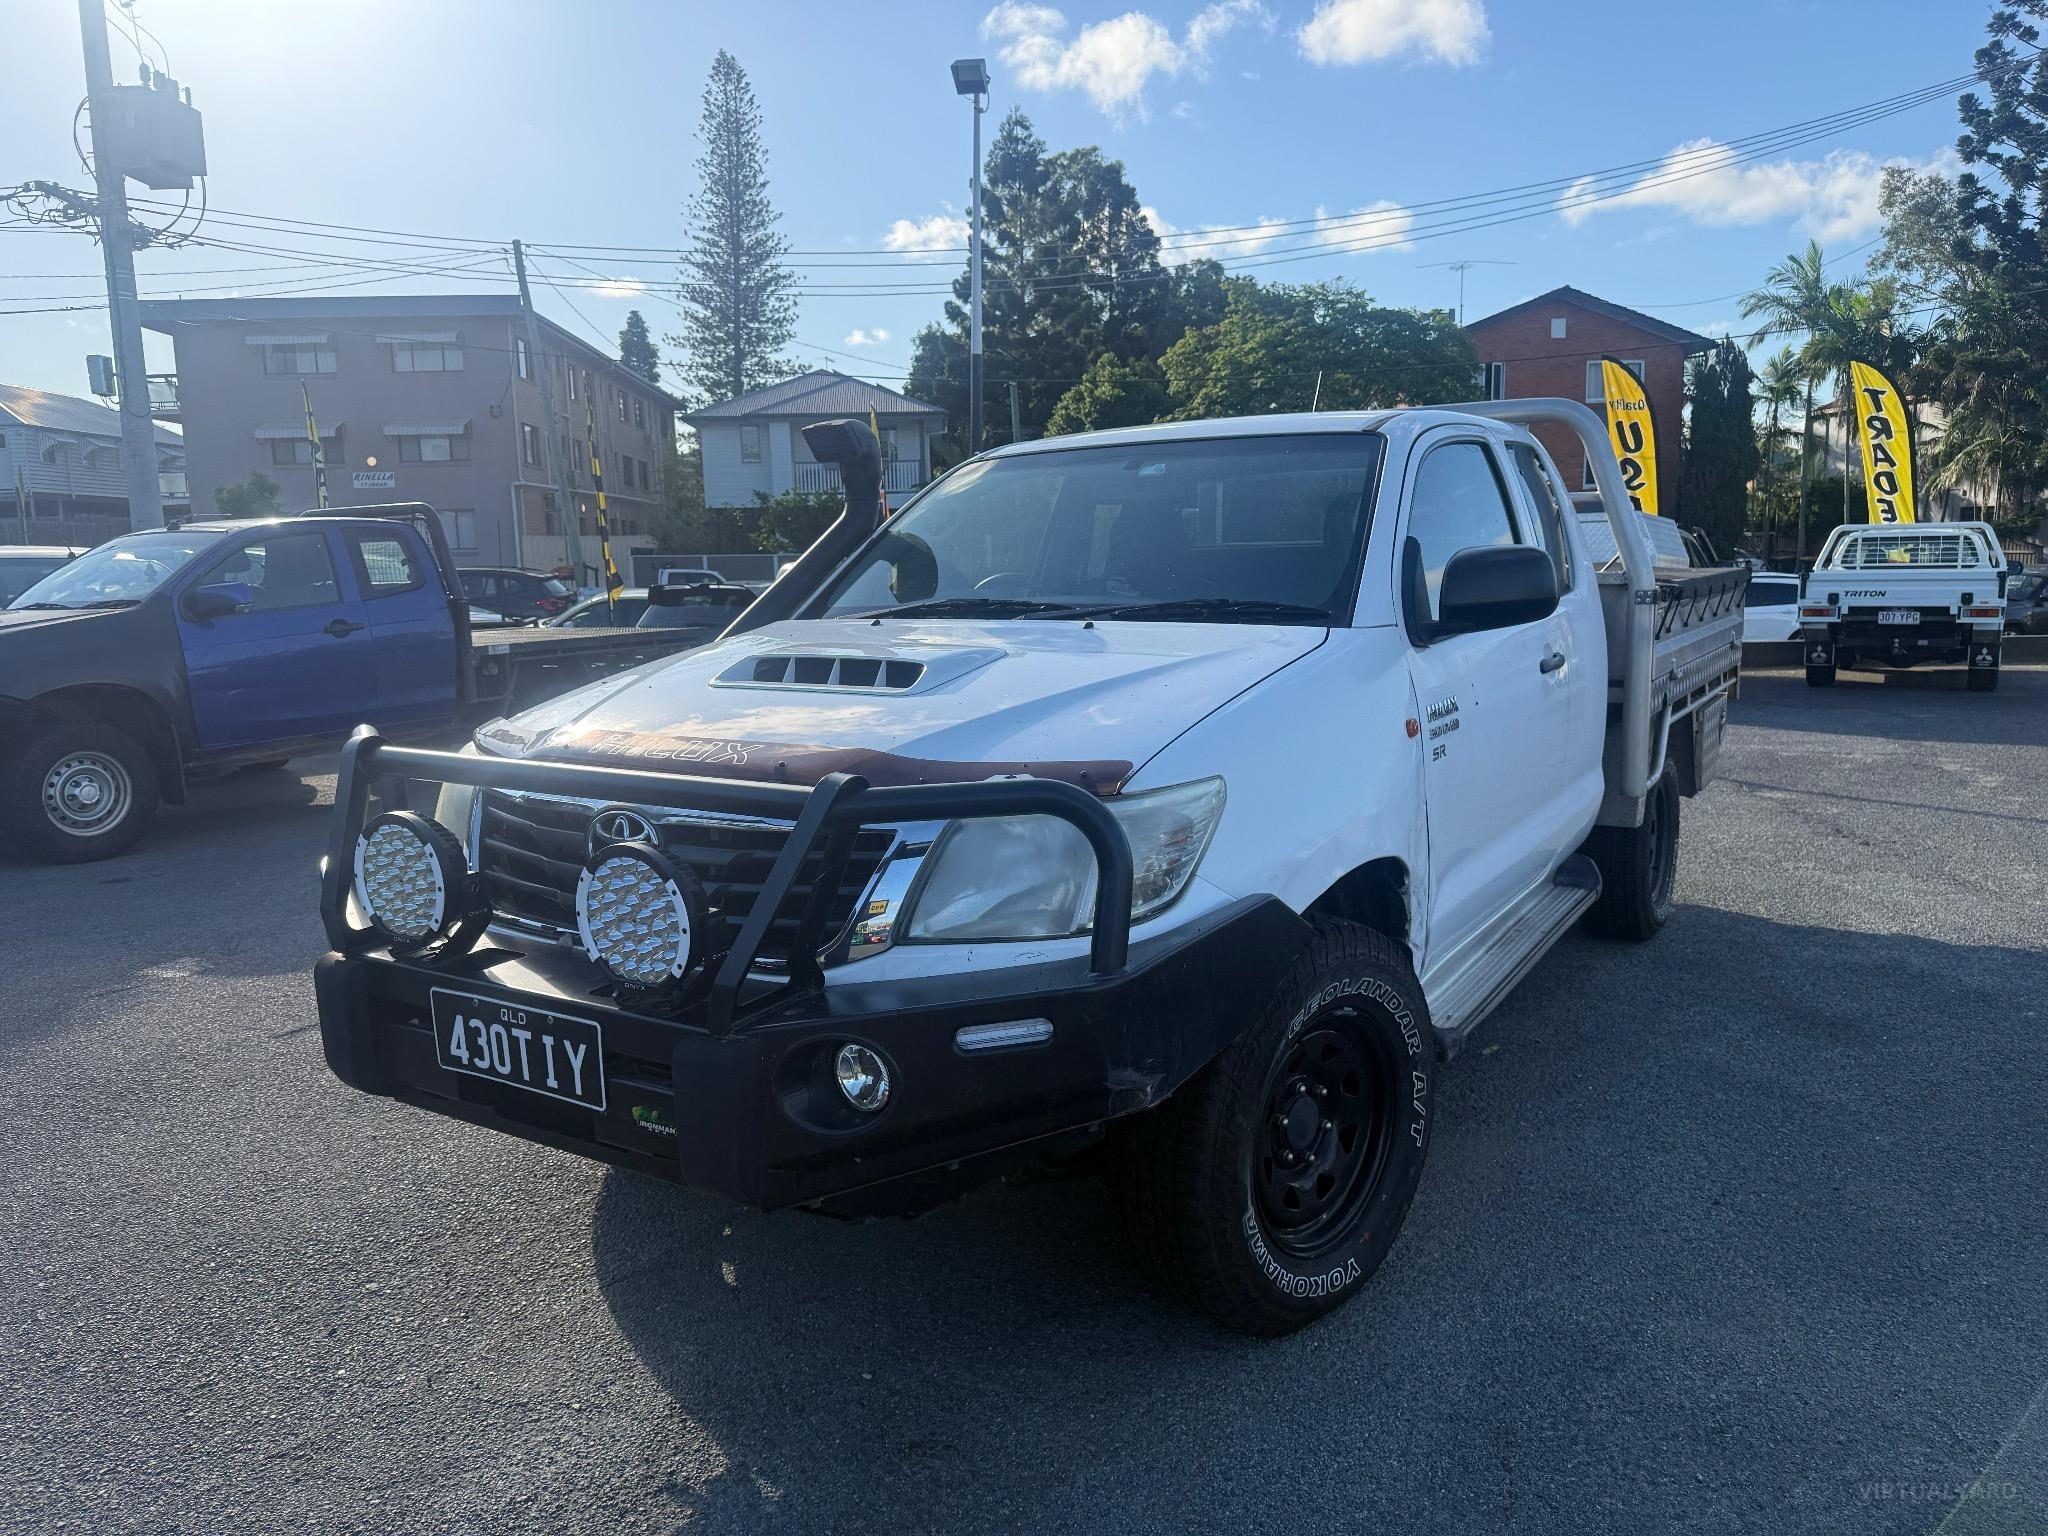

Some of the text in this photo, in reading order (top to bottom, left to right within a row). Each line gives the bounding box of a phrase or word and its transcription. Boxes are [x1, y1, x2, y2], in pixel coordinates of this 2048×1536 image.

[353, 472, 394, 481] RINELLA
[1843, 590, 1886, 598] TRITON
[1879, 612, 1918, 622] 307 YPG
[1426, 695, 1459, 723] HILUX
[588, 734, 765, 765] HILUX
[1432, 743, 1447, 762] SR
[500, 1008, 527, 1025] QLD
[1288, 977, 1427, 1147] GEOLANDAR A/T
[639, 1120, 677, 1135] IRONMAN
[1242, 1207, 1362, 1297] YOKOHAMA
